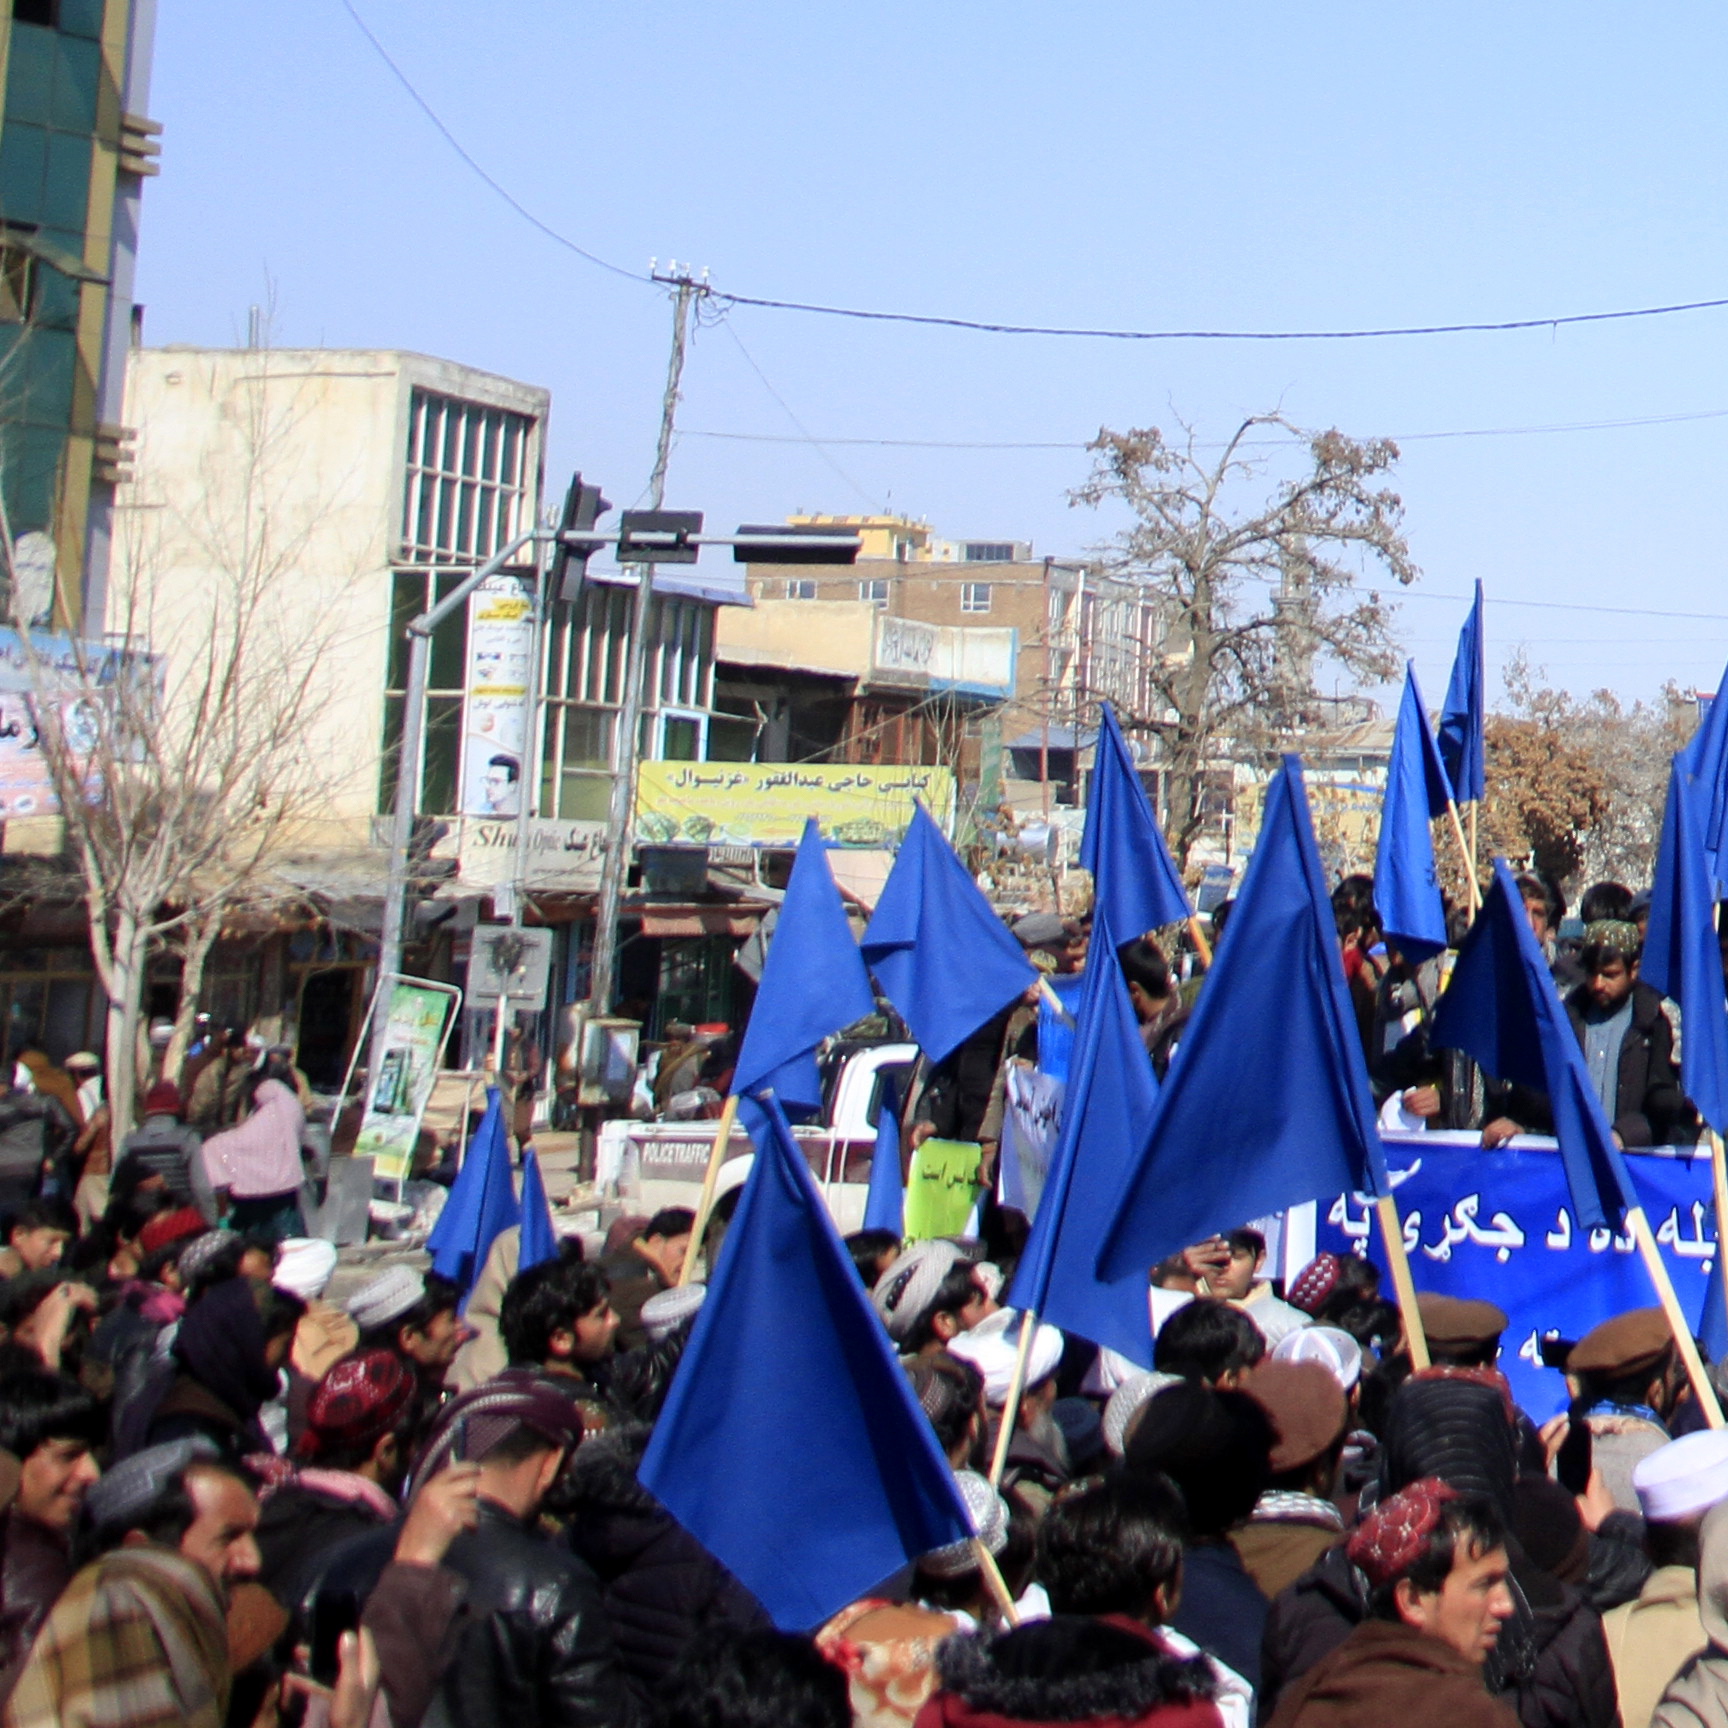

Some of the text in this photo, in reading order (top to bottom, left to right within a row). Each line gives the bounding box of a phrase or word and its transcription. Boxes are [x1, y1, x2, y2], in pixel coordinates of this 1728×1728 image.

[755, 771, 824, 792] عبدالغفور
[642, 1141, 711, 1165] POLICE TRAFFIC
[1327, 1190, 1374, 1262] په
[1544, 1206, 1573, 1251] د
